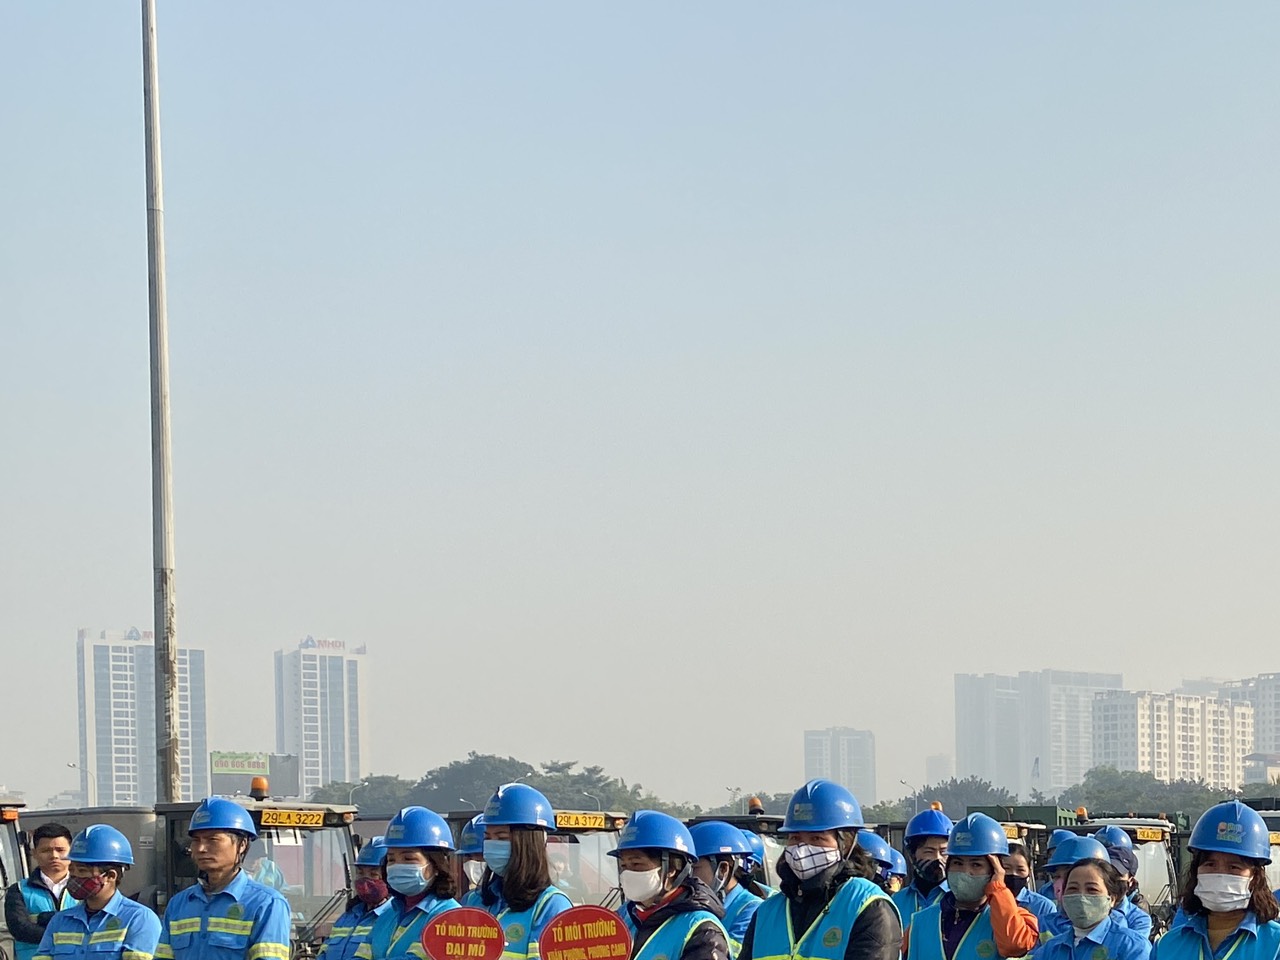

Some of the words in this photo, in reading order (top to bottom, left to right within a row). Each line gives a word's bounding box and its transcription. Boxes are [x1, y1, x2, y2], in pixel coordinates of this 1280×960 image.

[294, 813, 322, 825] 3222
[557, 815, 580, 826] 29LA
[581, 816, 604, 827] 3172
[435, 920, 447, 936] TỔ
[448, 923, 465, 937] MÔI
[467, 924, 498, 939] TRƯỜNG
[552, 920, 563, 943] TỔ
[564, 921, 582, 942] MÔI
[582, 918, 617, 939] TRƯỜNG
[446, 942, 465, 959] ĐẠI
